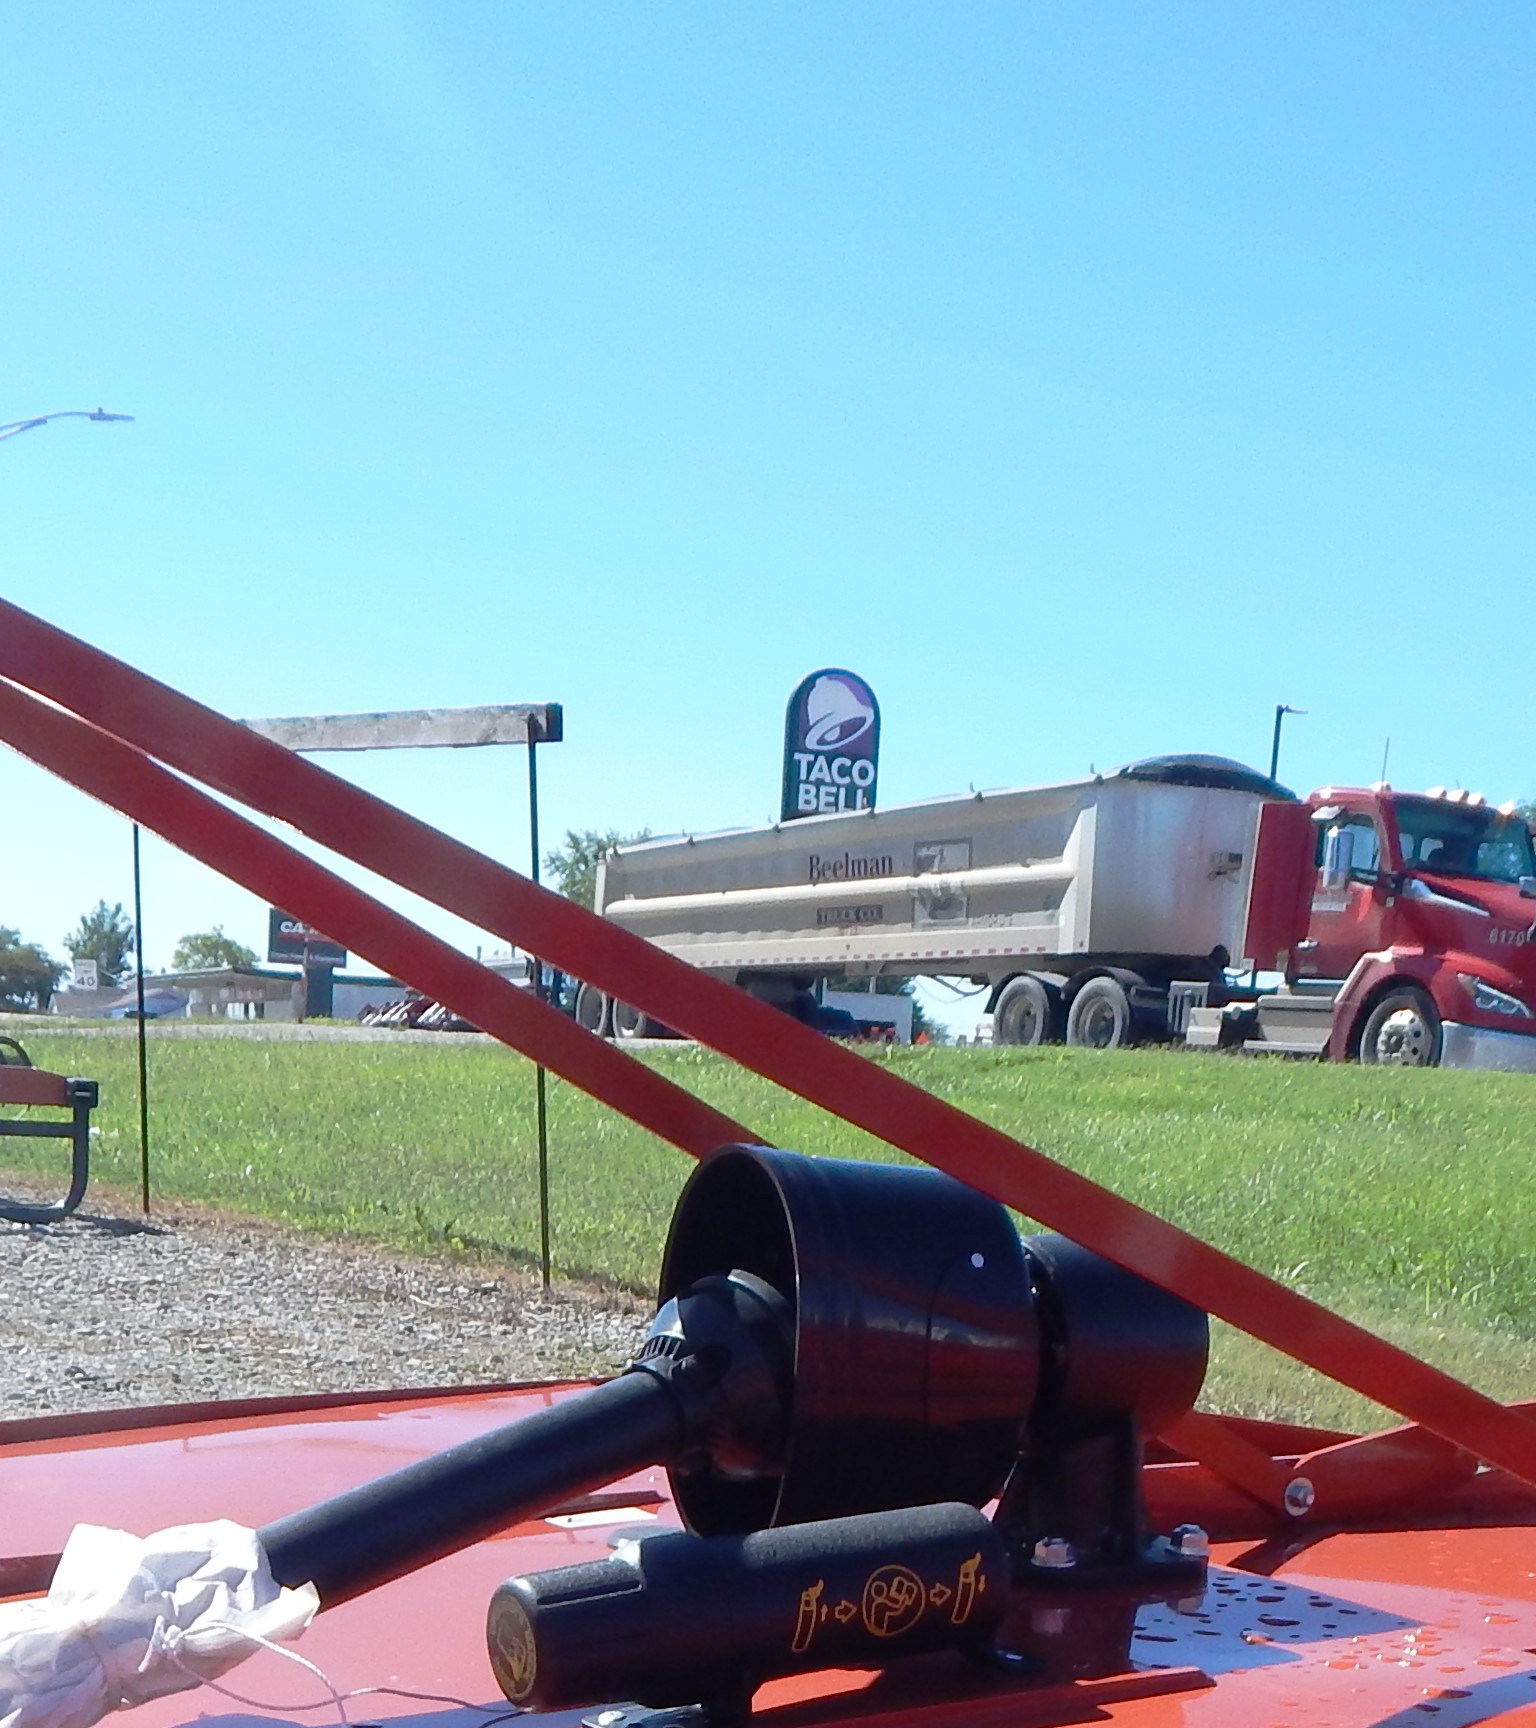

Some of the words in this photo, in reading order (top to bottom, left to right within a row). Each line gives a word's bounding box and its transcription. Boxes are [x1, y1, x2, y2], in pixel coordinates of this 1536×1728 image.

[793, 752, 875, 787] TACO
[797, 783, 868, 812] BELL
[809, 852, 893, 881] Beelman
[76, 976, 96, 987] 40
